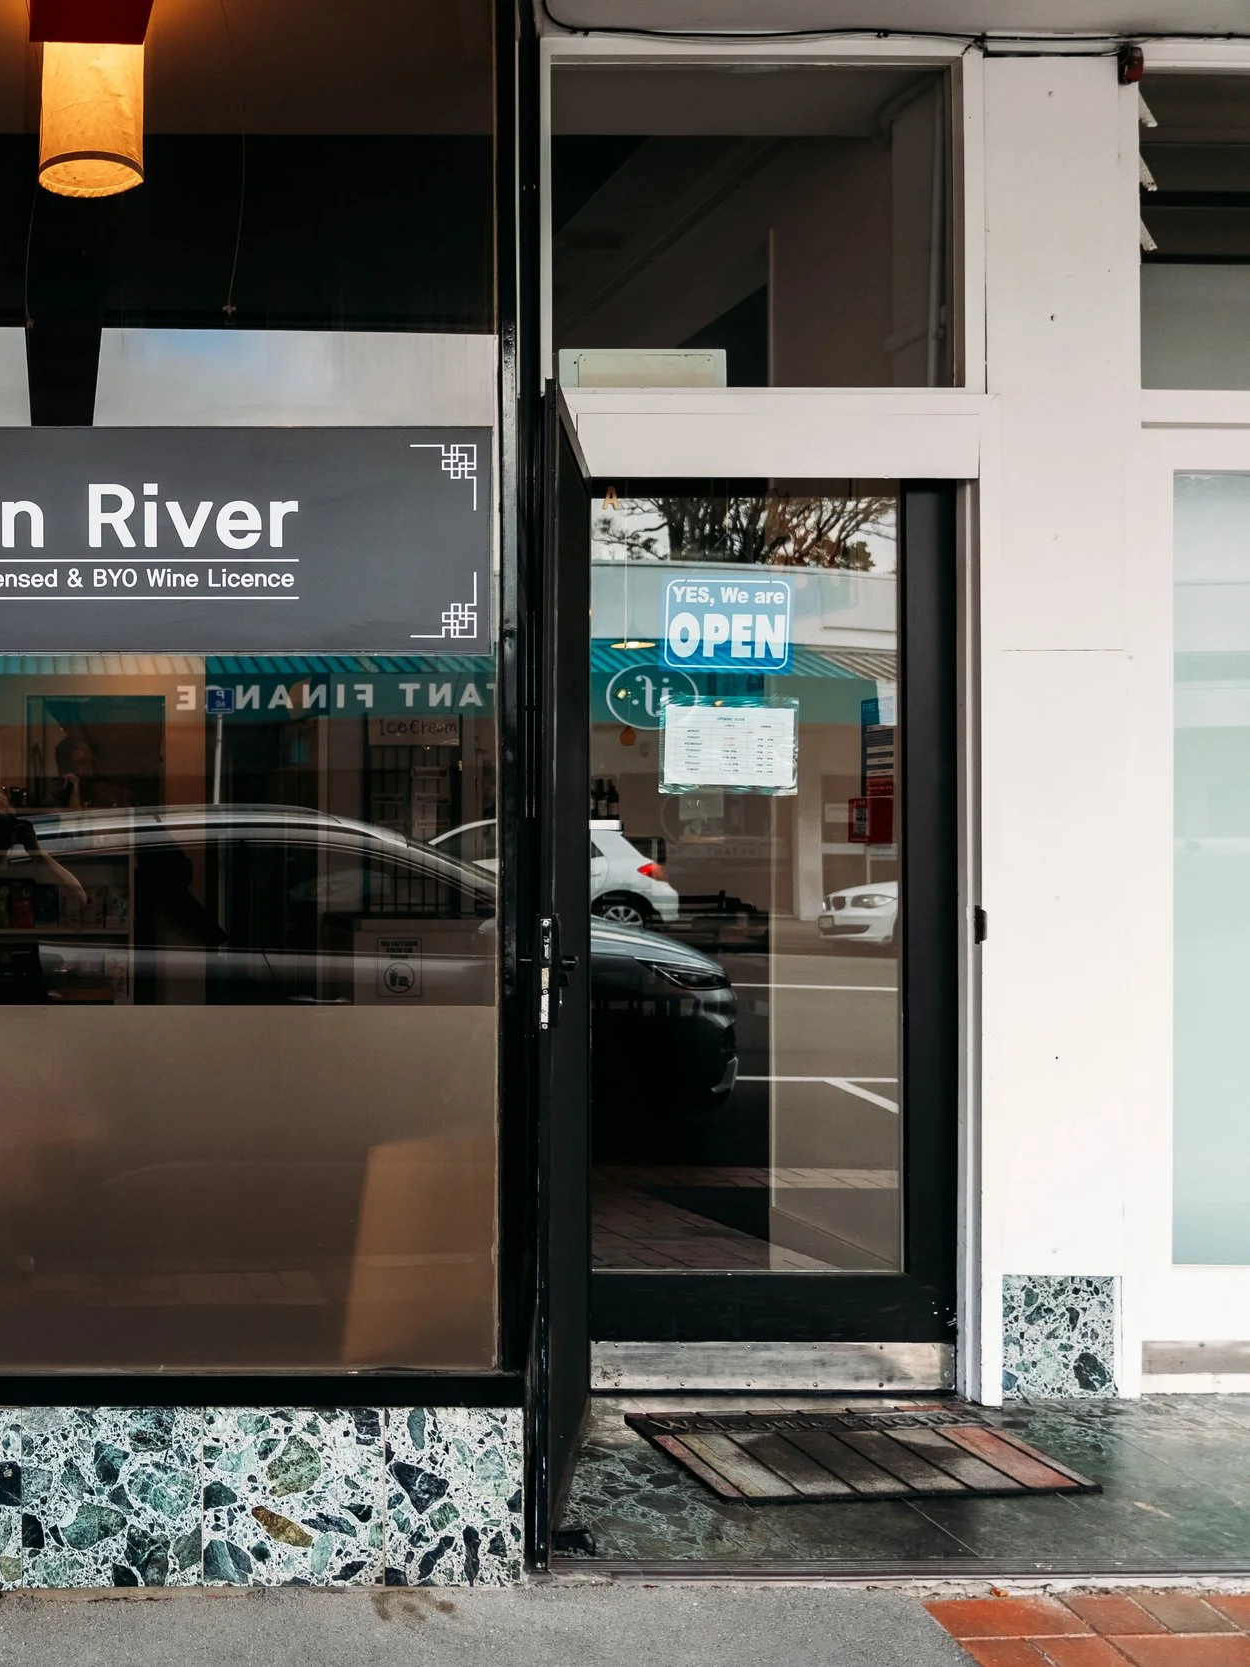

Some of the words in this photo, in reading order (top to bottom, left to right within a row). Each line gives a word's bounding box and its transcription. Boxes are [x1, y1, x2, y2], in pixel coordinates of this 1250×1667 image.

[88, 483, 299, 549] River
[66, 567, 84, 588] &
[93, 567, 138, 588] BYO
[145, 568, 200, 588] Wine
[208, 568, 295, 588] Licence
[672, 586, 715, 607] YES,
[720, 586, 749, 604] We
[754, 588, 786, 606] are
[668, 612, 787, 660] OPEN
